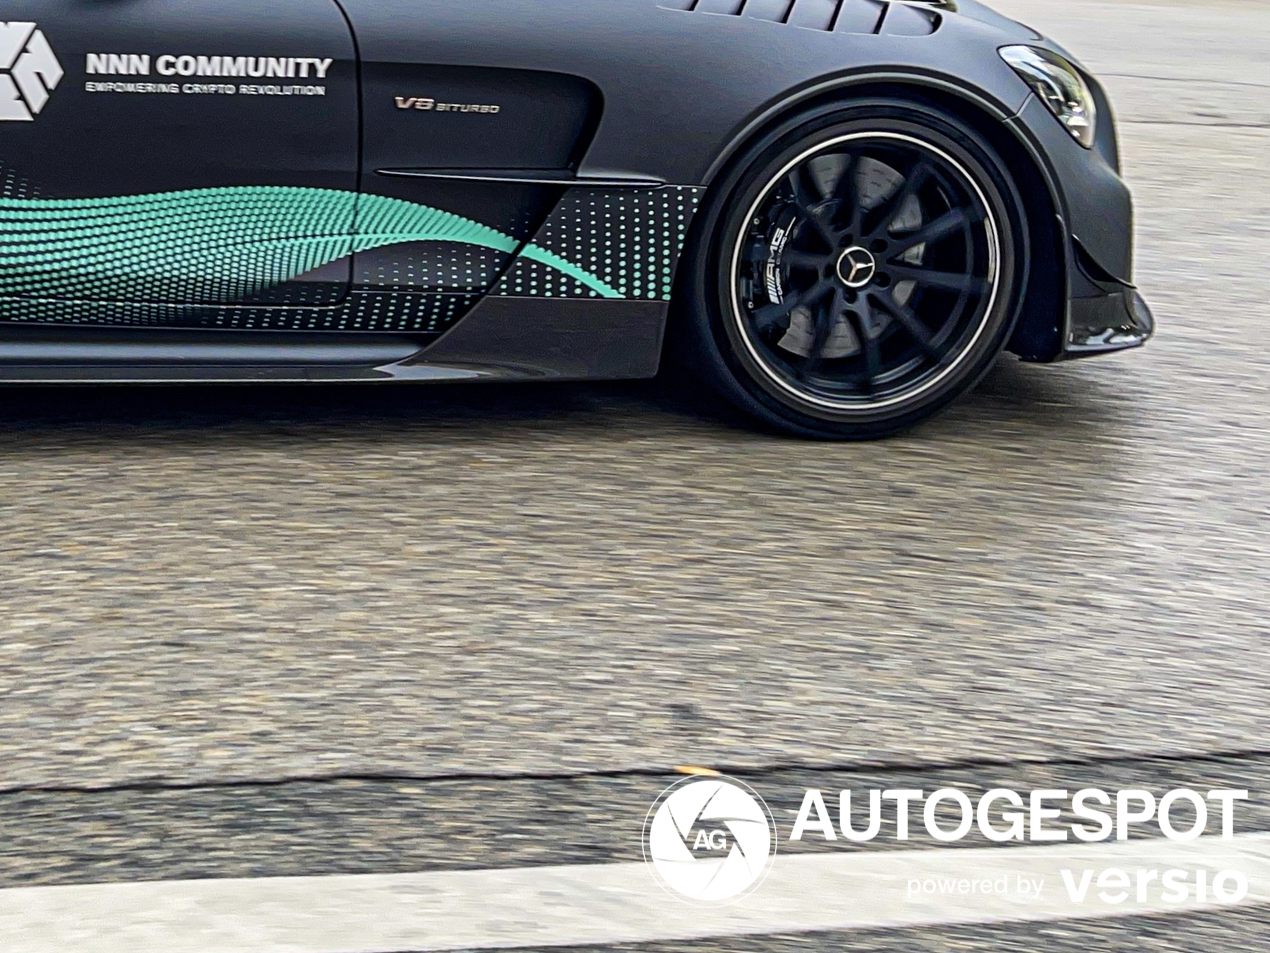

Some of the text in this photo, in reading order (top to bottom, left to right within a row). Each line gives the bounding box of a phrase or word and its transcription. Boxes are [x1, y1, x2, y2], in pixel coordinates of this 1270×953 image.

[85, 53, 333, 78] NNN COMMUNITY
[84, 81, 326, 96] EMPOWERING CRYPTO REVOLUTION
[394, 96, 501, 114] V8 BITURBO
[766, 227, 785, 281] AMG
